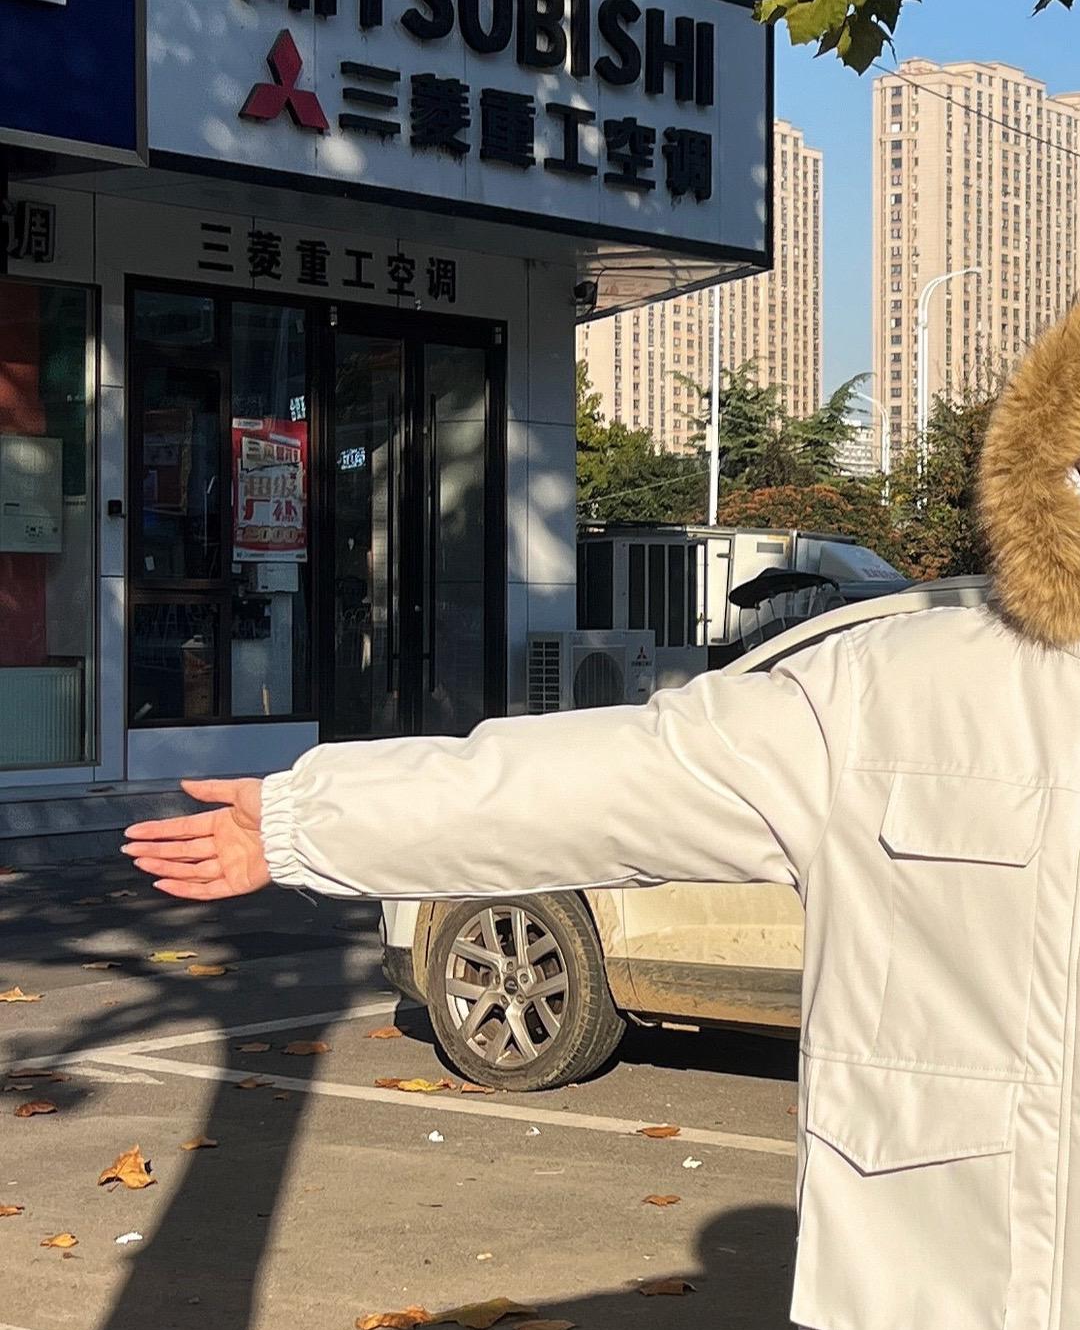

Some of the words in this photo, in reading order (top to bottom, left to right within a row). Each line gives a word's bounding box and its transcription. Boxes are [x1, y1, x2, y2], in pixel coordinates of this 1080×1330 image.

[338, 60, 713, 202] 三菱重工空调
[198, 222, 457, 303] 三菱重工空调
